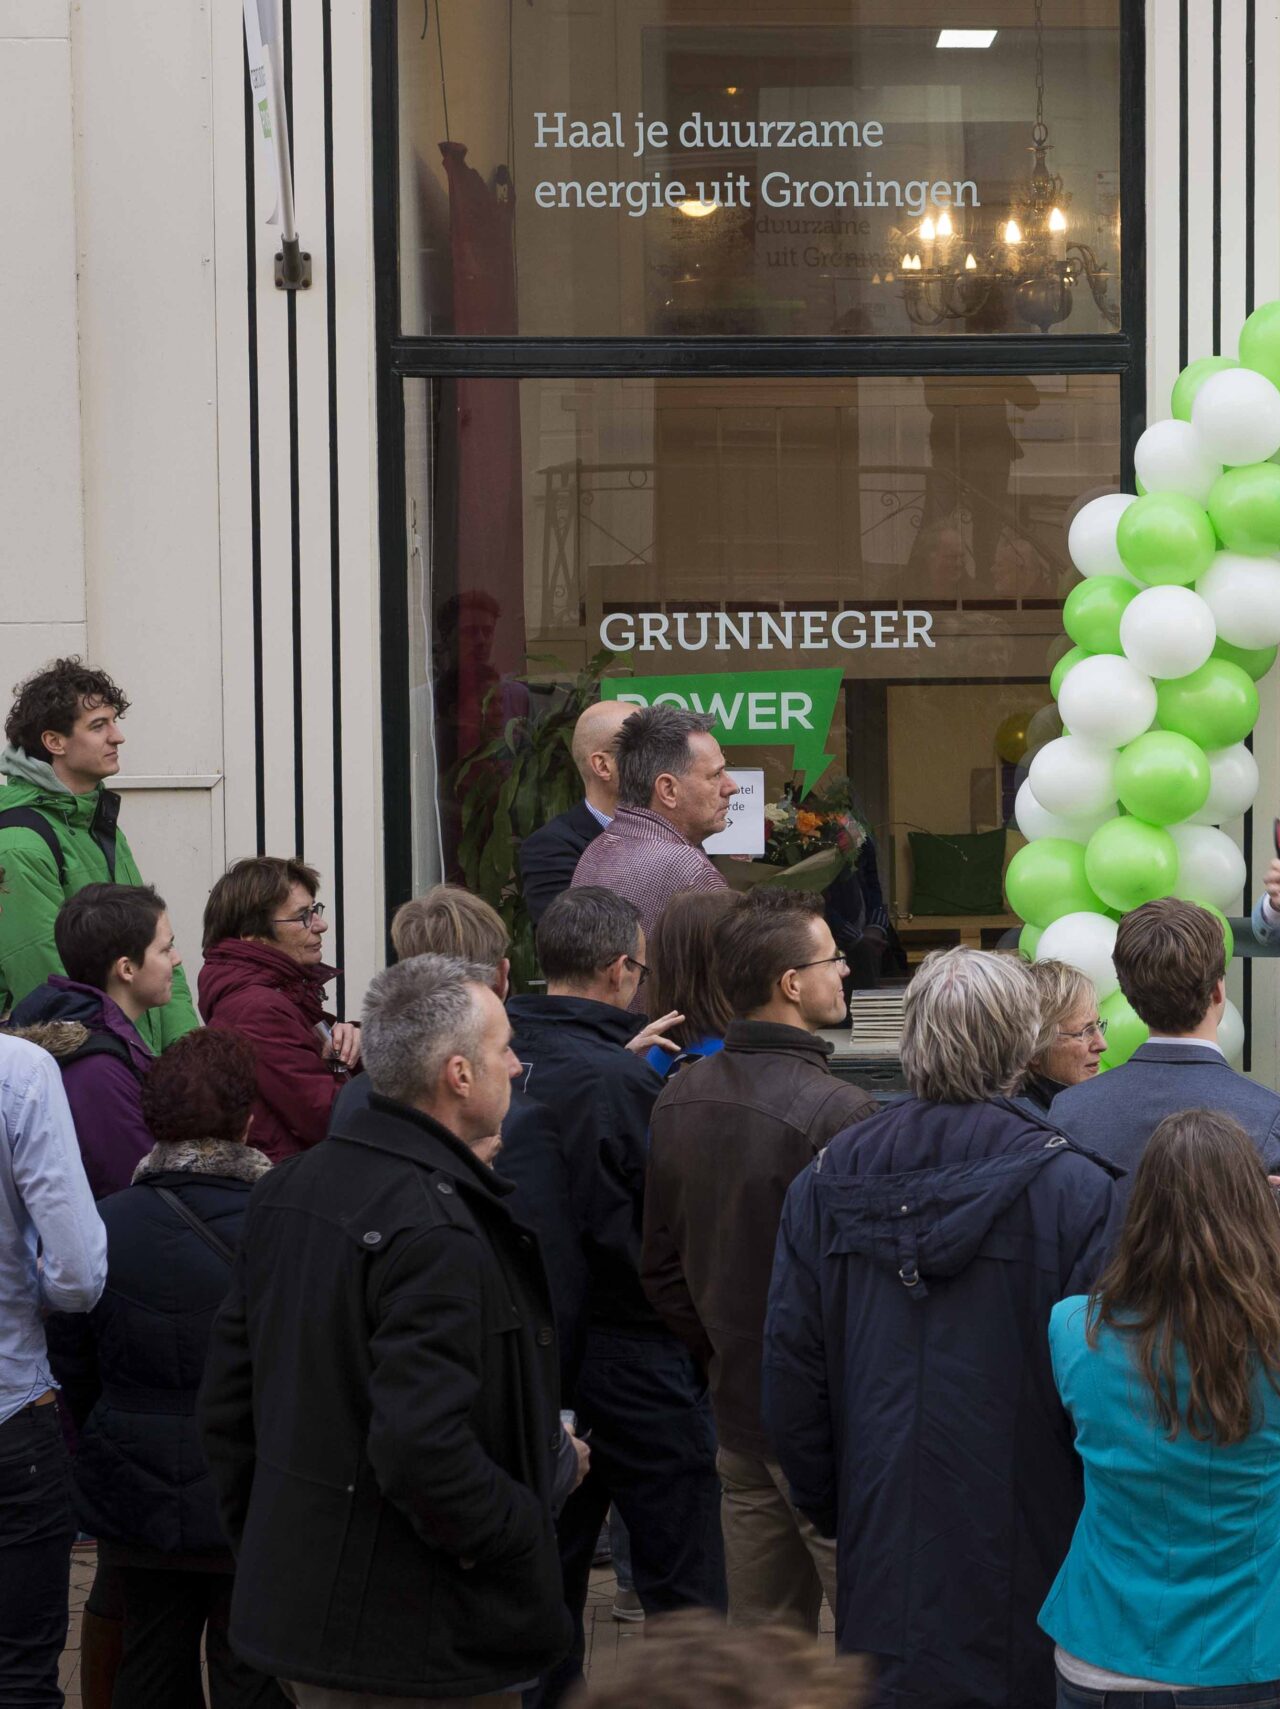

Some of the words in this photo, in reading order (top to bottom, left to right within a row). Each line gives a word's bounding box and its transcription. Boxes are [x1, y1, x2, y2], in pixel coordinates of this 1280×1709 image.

[533, 112, 625, 149] Haal
[632, 112, 670, 158] je
[678, 112, 885, 149] duurzame
[533, 172, 686, 218] energie
[694, 172, 751, 209] uit
[760, 172, 982, 218] Groningen
[600, 610, 936, 651] GRUNNEGER
[617, 692, 815, 730] WER
